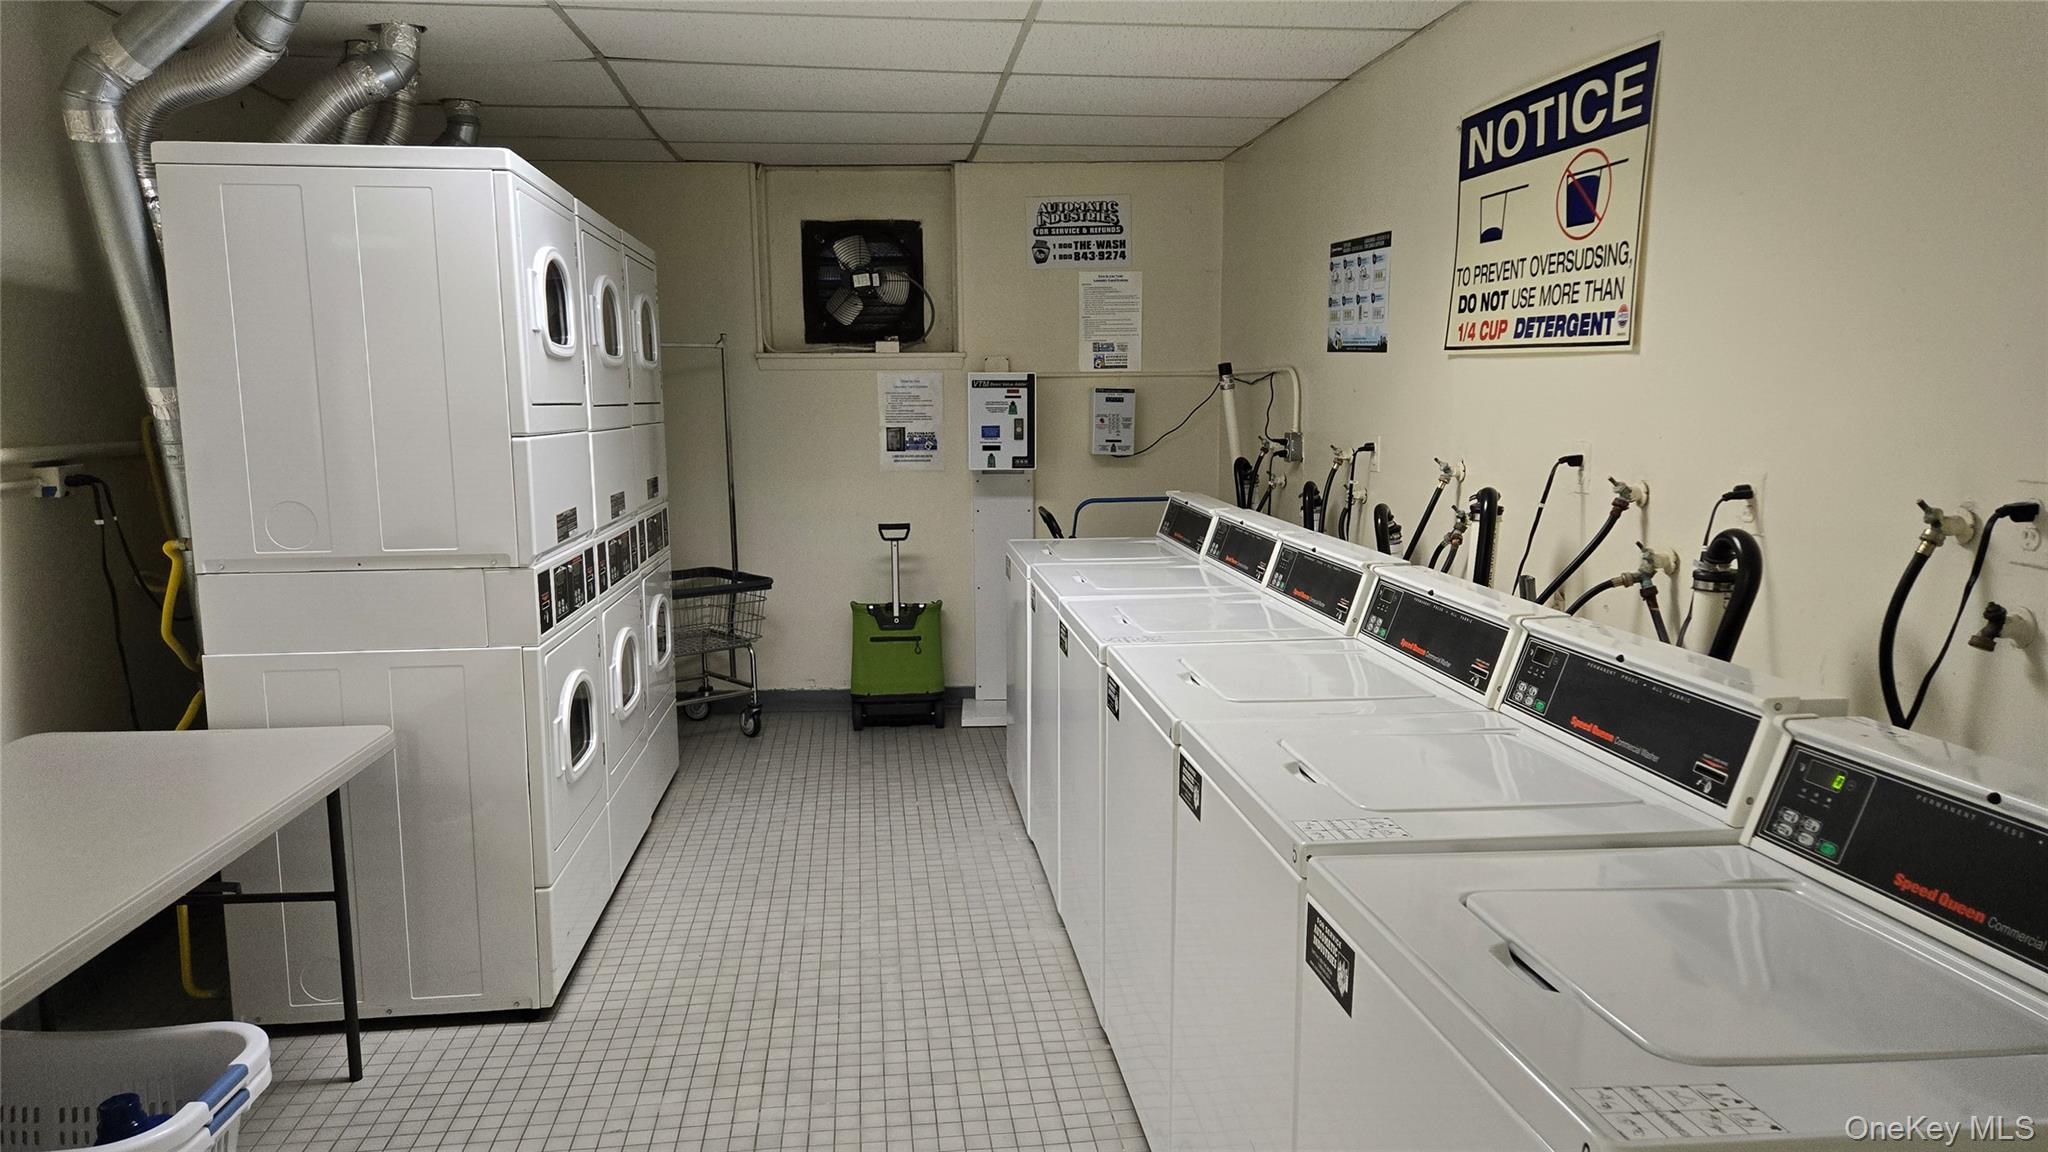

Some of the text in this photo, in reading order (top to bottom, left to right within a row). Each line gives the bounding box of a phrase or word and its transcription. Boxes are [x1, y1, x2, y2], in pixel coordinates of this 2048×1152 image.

[1467, 61, 1648, 170] NOTICE
[1037, 211, 1120, 226] INDUSTRIES
[1038, 201, 1119, 213] AUTOMATIC
[1456, 240, 1633, 287] TO PREVENT OVERSUDSING,
[1457, 276, 1626, 314] DO NOT USE MORE THAN
[1457, 321, 1476, 342] 1/4
[1479, 319, 1509, 341] CUP
[1513, 310, 1616, 340] DETERGENT
[1569, 714, 1592, 731] Speed
[1916, 794, 2026, 839] PERMANENT PRESS
[1893, 872, 2047, 951] Speed Queen Commercial
